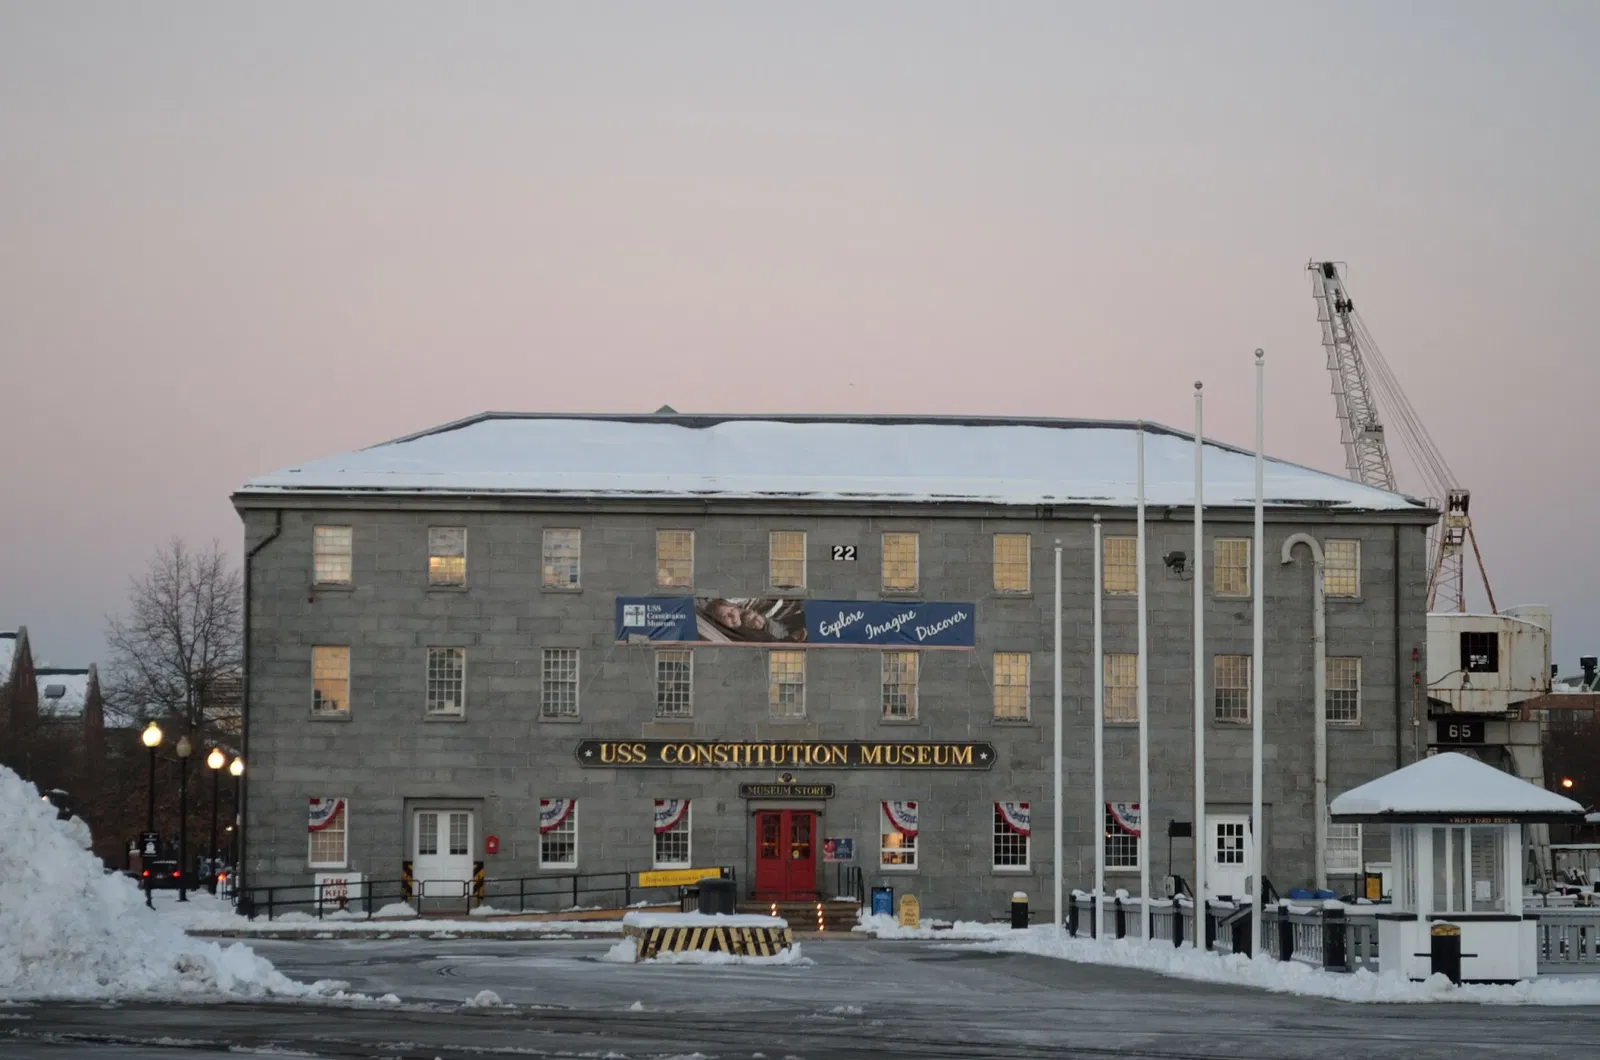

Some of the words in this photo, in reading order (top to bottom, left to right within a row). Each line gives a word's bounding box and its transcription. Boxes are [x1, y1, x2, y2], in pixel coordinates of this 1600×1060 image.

[833, 545, 855, 561] 22
[646, 604, 662, 612] USS
[819, 610, 864, 638] Explore
[865, 609, 916, 640] Imagine
[915, 610, 968, 641] Discover
[1449, 724, 1471, 738] 65
[600, 743, 647, 763] USS
[660, 743, 847, 764] CONSTITUTION
[860, 745, 974, 764] MUSEUM
[748, 786, 791, 795] MUSEUM
[795, 786, 826, 795] STORE
